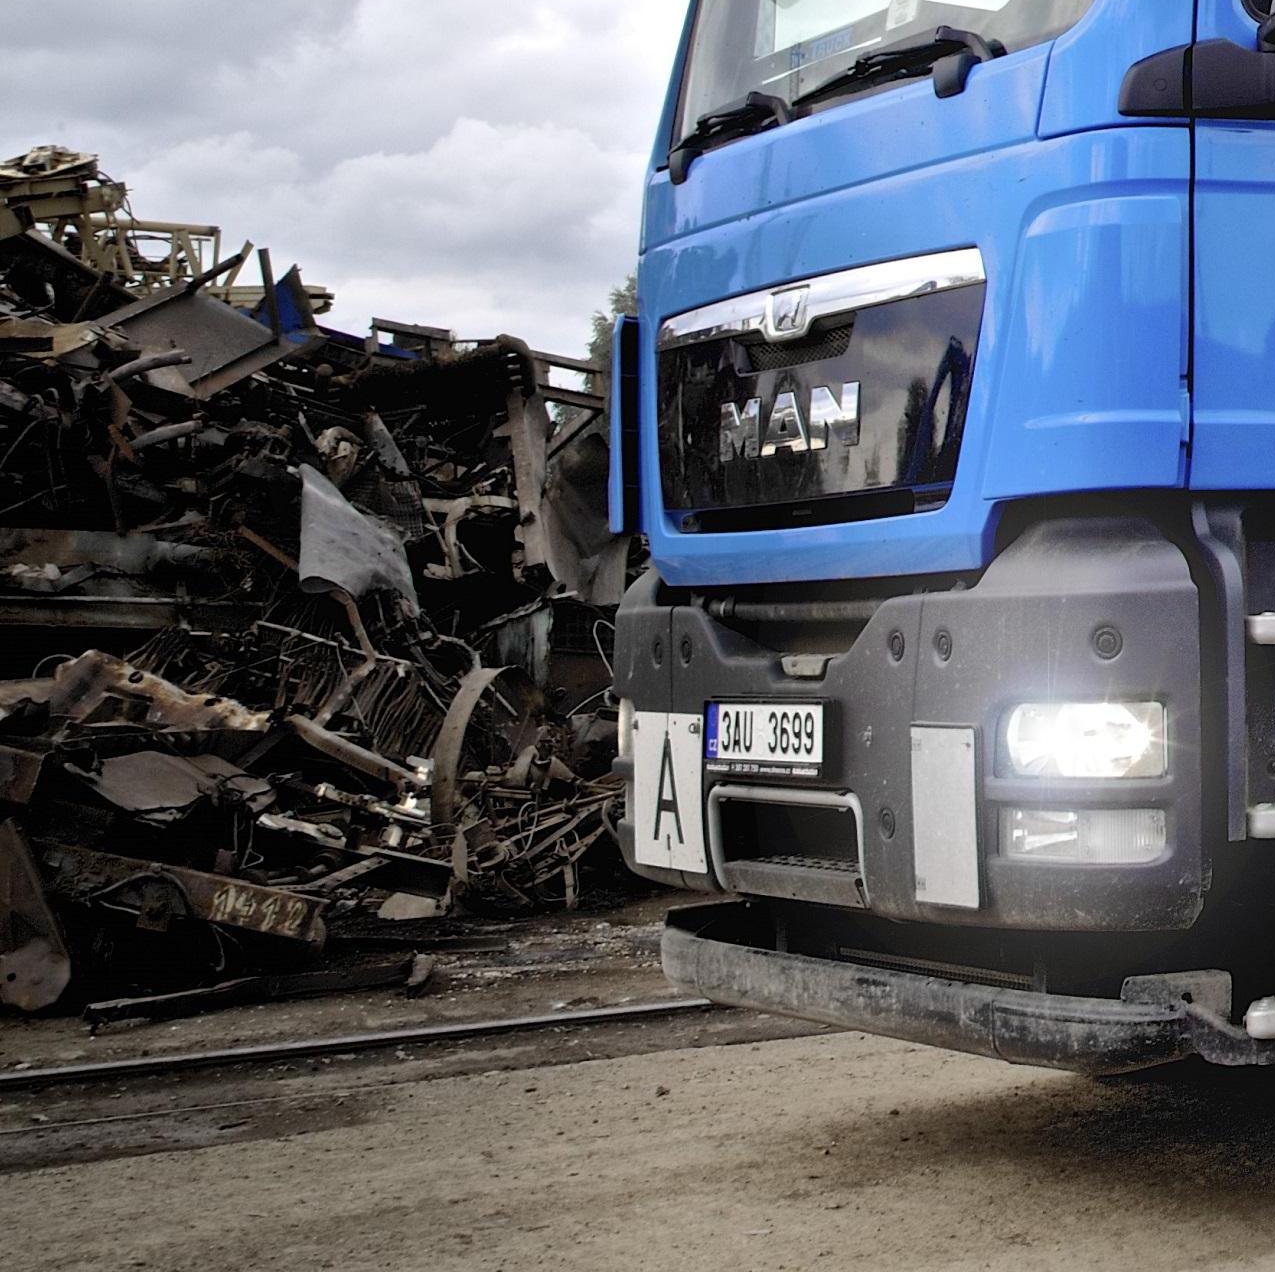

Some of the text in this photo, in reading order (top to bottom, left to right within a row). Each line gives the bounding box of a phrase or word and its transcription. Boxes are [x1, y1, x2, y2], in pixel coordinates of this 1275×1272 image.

[719, 380, 861, 463] MAN
[708, 739, 718, 752] CZ
[721, 711, 815, 754] 3AU 3699
[654, 733, 684, 845] A
